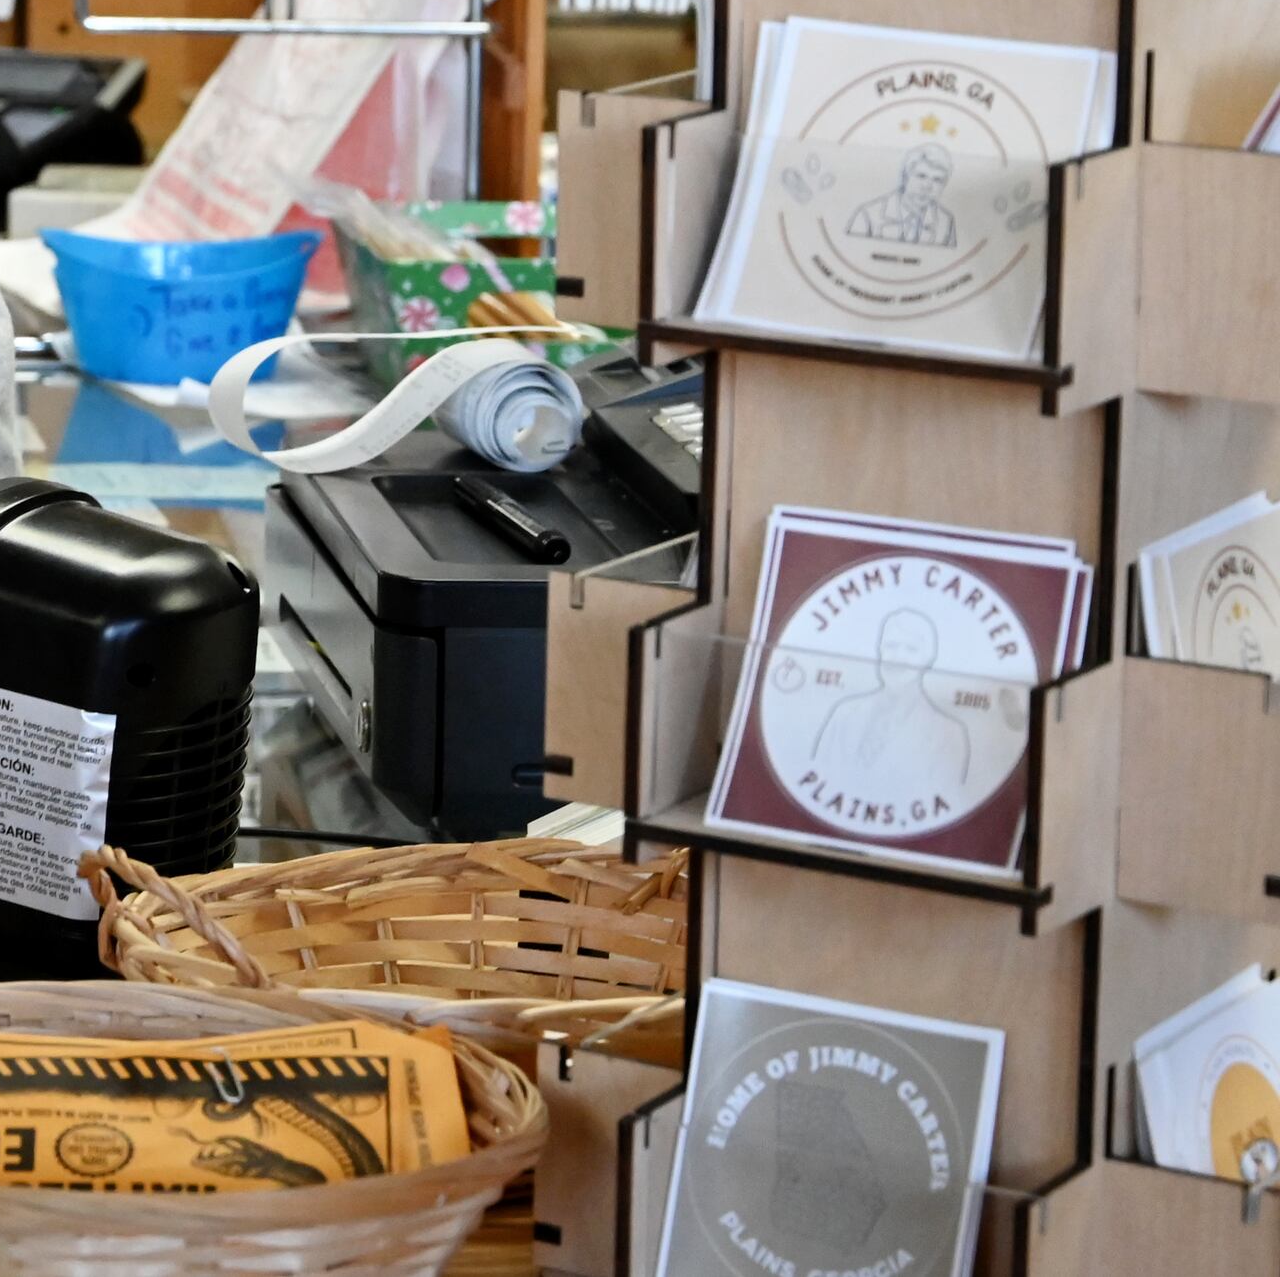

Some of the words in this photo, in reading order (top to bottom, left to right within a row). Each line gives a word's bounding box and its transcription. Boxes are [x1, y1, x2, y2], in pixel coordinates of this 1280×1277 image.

[967, 81, 995, 111] GA
[811, 563, 903, 632] JIMMY
[924, 564, 1020, 660] CARTER
[2, 722, 21, 735] other
[23, 718, 42, 732] keep
[45, 724, 79, 740] electrical
[8, 744, 20, 755] the
[22, 748, 38, 759] side
[41, 753, 54, 764] and
[16, 736, 28, 746] the
[31, 739, 48, 751] front
[59, 747, 72, 758] the
[74, 751, 100, 765] heater
[23, 777, 62, 796] mantenga
[64, 787, 90, 802] cables
[35, 799, 45, 809] de
[81, 820, 91, 831] de
[706, 1072, 766, 1150] HOME
[765, 1050, 800, 1080] OF
[808, 1046, 899, 1084] JIMMY
[897, 1080, 951, 1192] CARTER
